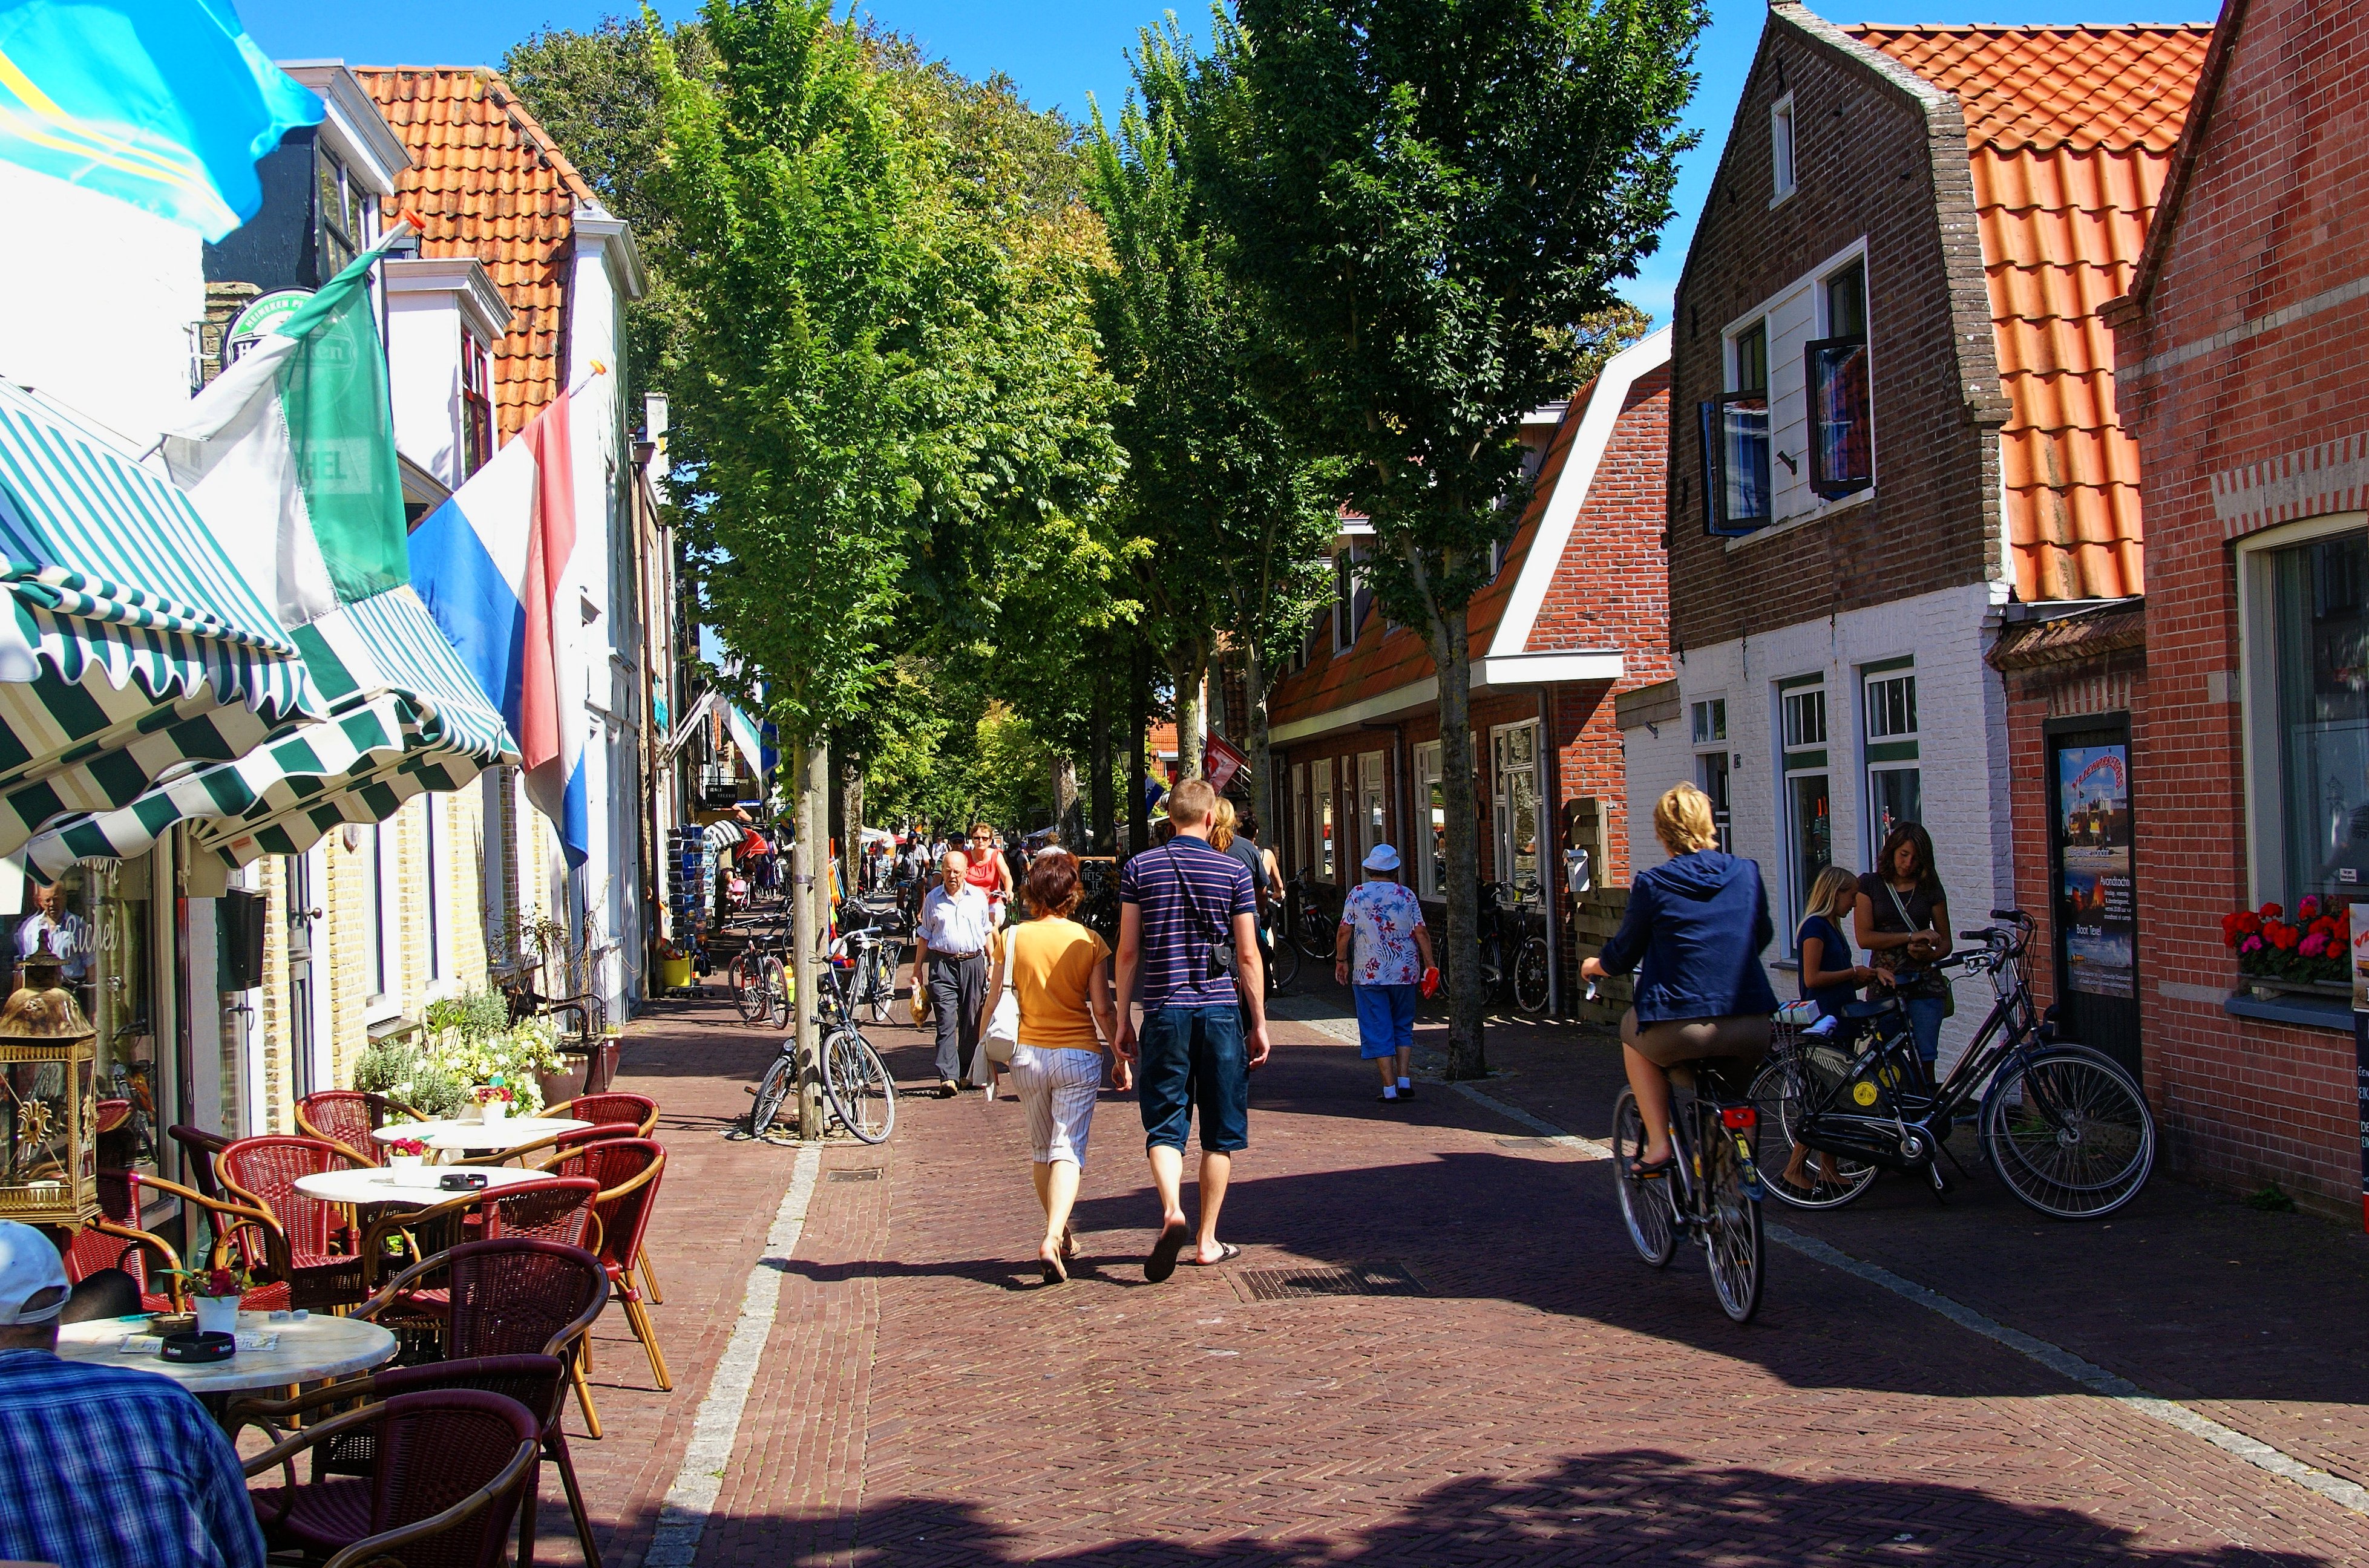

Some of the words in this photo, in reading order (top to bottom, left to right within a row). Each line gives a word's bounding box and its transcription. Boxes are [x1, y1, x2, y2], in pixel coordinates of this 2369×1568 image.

[246, 300, 289, 328] HEINEKEN
[1083, 860, 1093, 872] 2
[1090, 881, 1100, 890] TE
[65, 909, 120, 957] Richel
[2077, 924, 2088, 935] Boot
[2089, 925, 2101, 936] Texel
